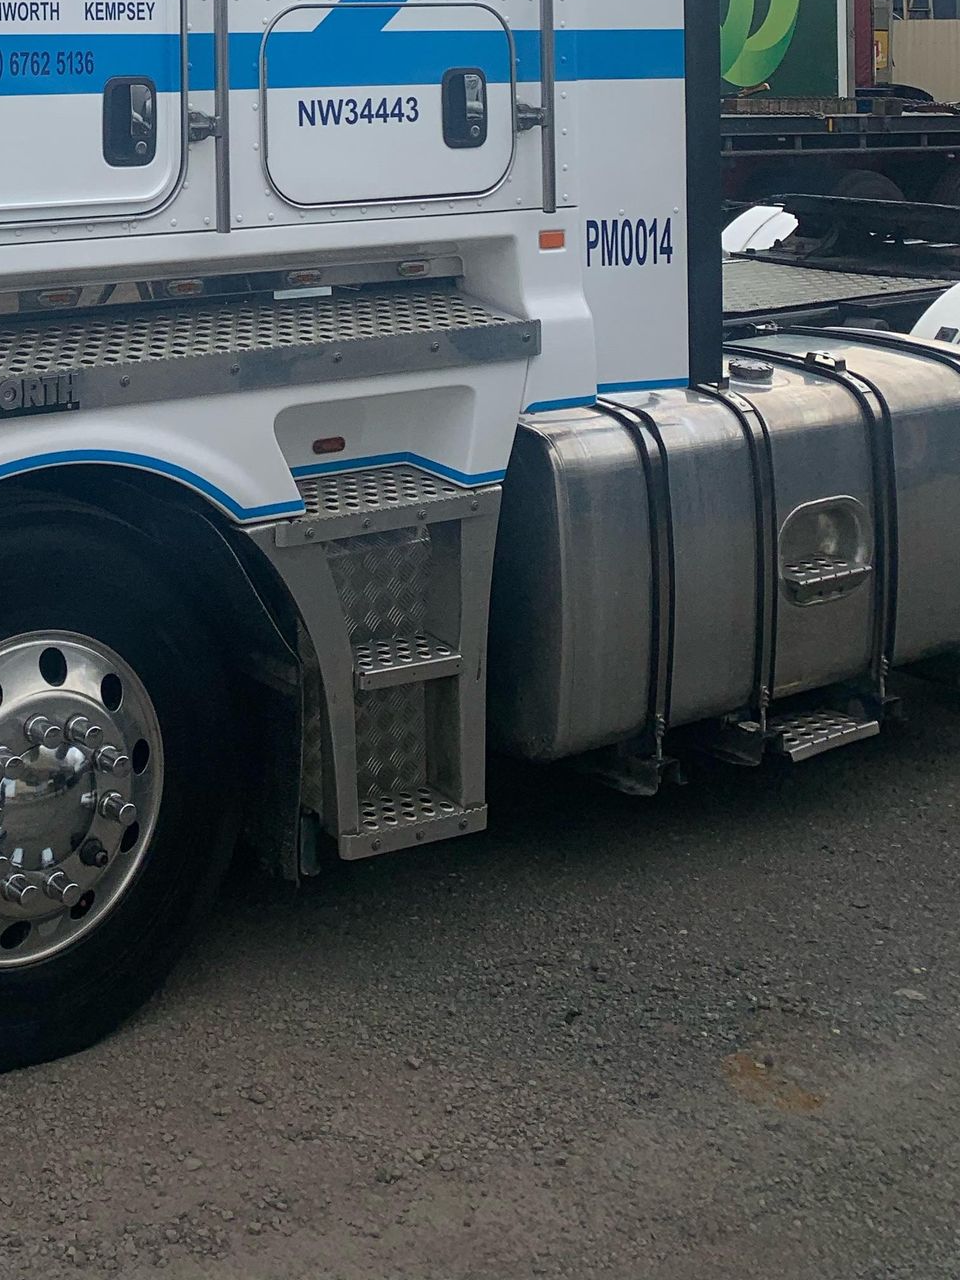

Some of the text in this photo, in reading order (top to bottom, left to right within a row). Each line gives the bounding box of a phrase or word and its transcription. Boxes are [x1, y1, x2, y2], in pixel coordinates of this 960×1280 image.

[84, 1, 156, 21] KEMPSEY
[9, 51, 51, 76] 6762
[56, 50, 94, 75] 5136
[298, 96, 420, 127] NW34443
